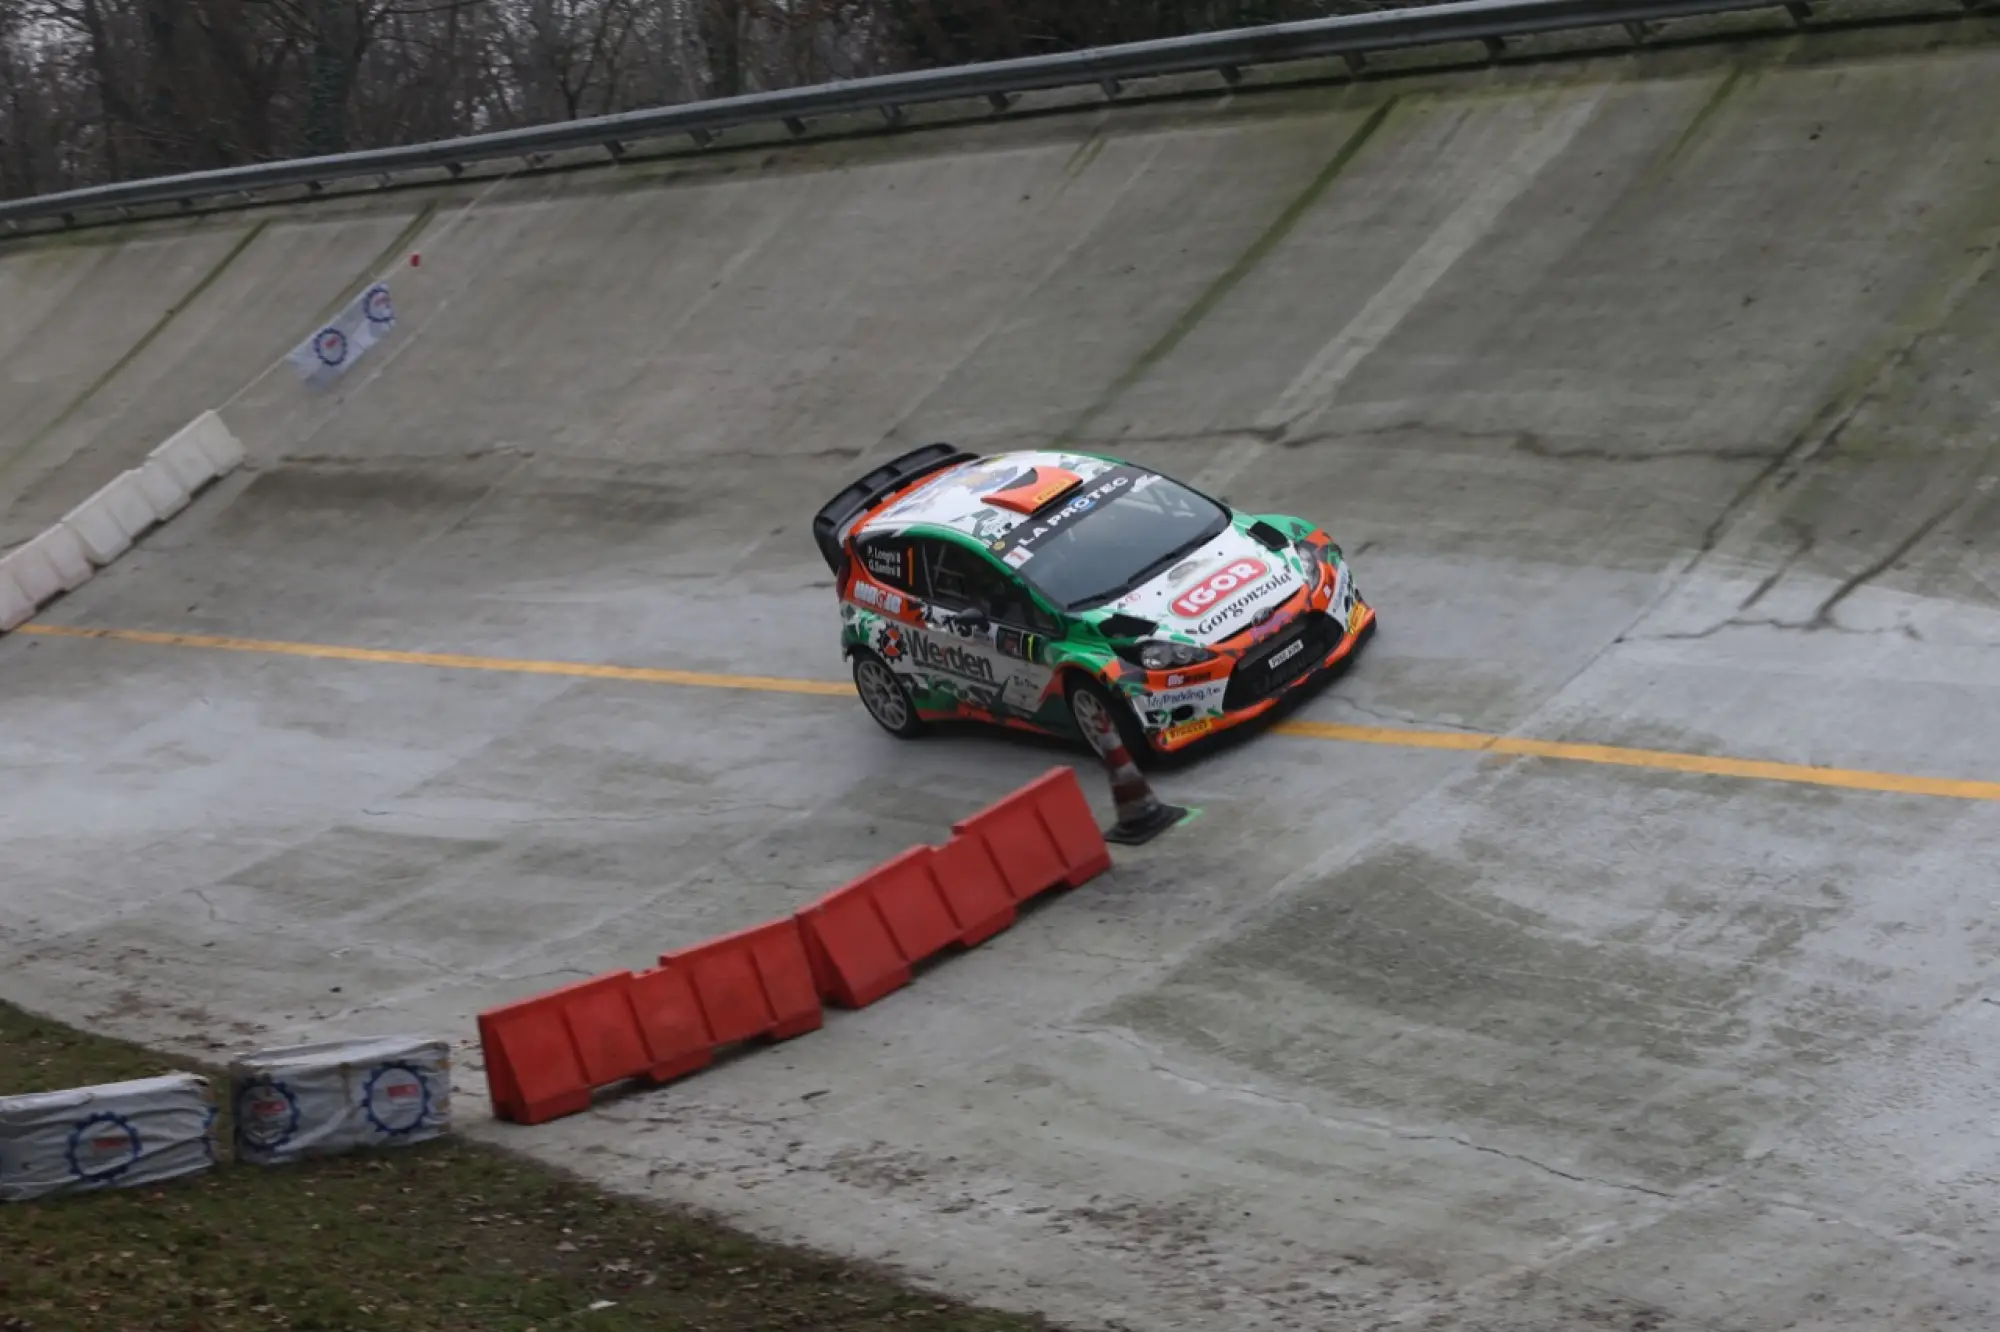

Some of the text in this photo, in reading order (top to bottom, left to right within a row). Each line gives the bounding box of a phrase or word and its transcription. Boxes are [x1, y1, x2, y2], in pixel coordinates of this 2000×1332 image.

[1017, 526, 1049, 547] LA
[1047, 475, 1129, 527] PROTEC
[1177, 563, 1259, 613] IGOR
[1197, 572, 1293, 635] Gorgonzola
[904, 628, 995, 682] Werden
